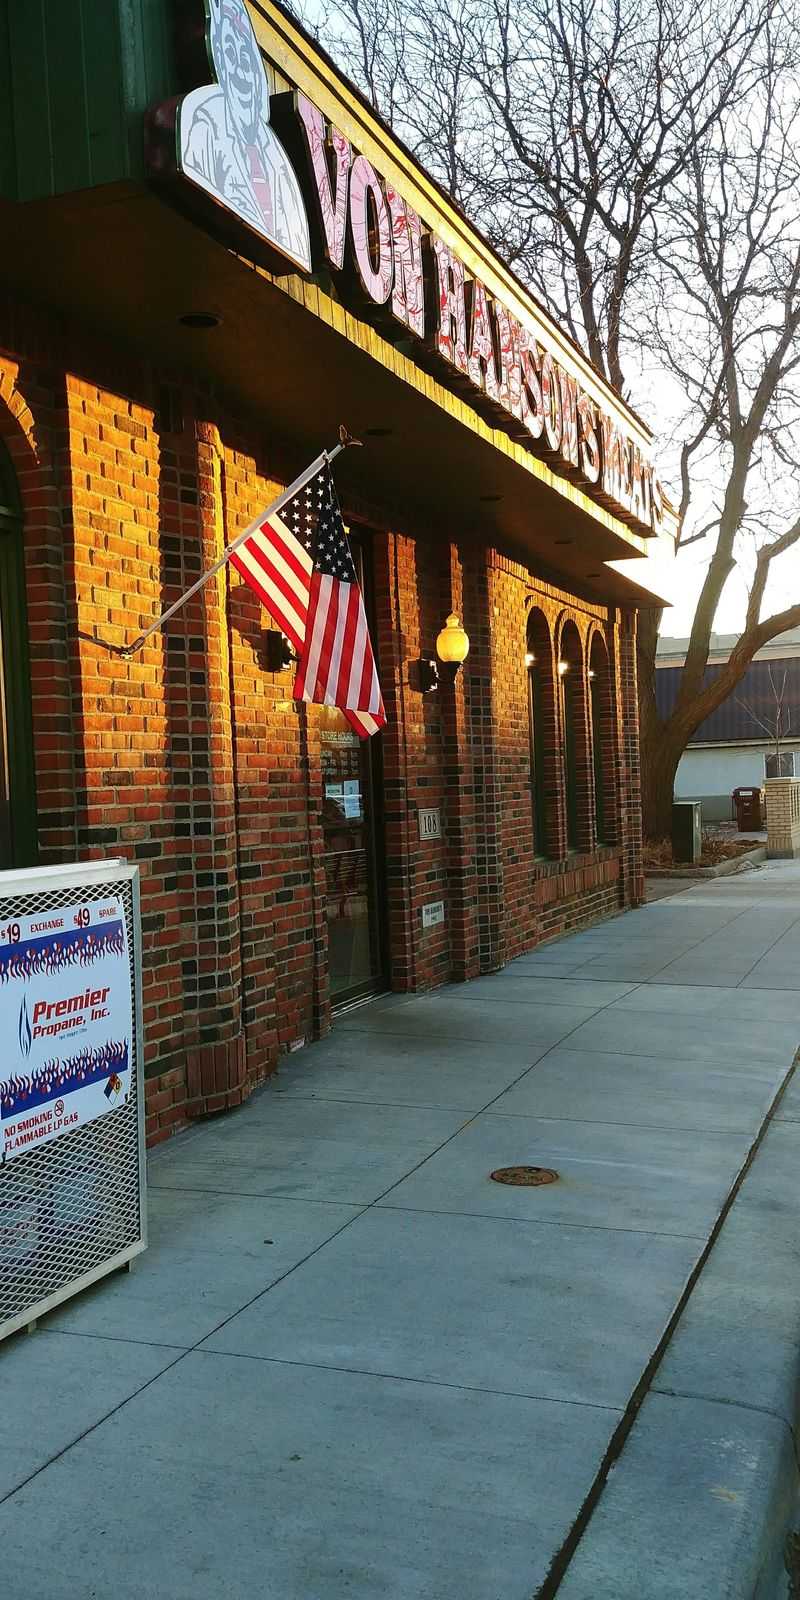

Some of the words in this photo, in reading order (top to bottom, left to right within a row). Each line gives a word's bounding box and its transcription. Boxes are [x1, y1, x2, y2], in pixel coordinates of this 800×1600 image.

[296, 88, 425, 340] VON
[599, 404, 663, 533] MEATS
[423, 814, 437, 833] 108
[1, 922, 21, 945] $19
[30, 918, 65, 933] EXCHANGE
[73, 907, 91, 929] $49
[98, 906, 117, 919] SPARE
[32, 986, 111, 1025] Premier
[32, 1015, 87, 1040] Propane,
[90, 1007, 111, 1021] Inc.
[4, 1126, 16, 1138] NO
[17, 1110, 53, 1133] SMOKING
[4, 1123, 53, 1153] FLAMMABLE
[53, 1117, 63, 1131] LP
[63, 1112, 79, 1127] GAS
